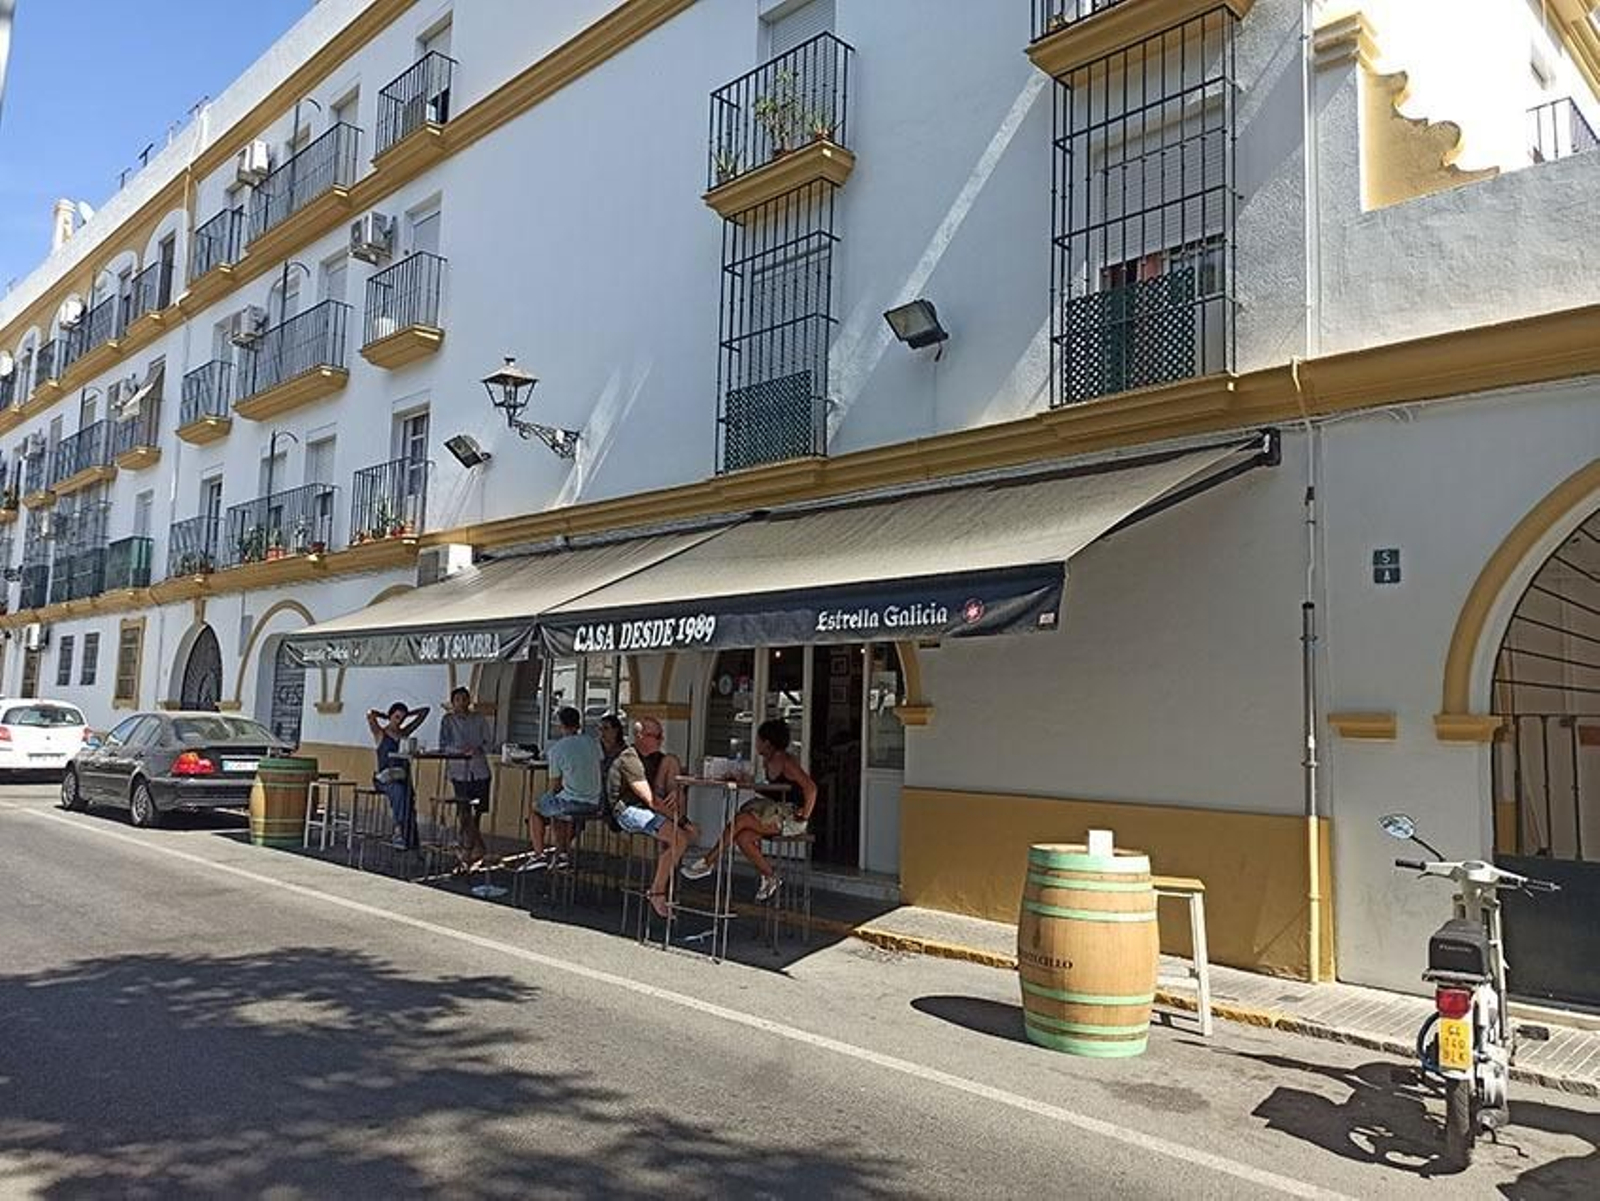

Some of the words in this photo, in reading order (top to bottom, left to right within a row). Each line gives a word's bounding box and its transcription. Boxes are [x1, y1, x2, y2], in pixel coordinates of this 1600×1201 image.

[573, 623, 614, 651] CASA
[618, 618, 675, 649] DESDE
[675, 613, 716, 643] 1989
[815, 611, 879, 631] Estrella
[883, 603, 948, 627] Galicia
